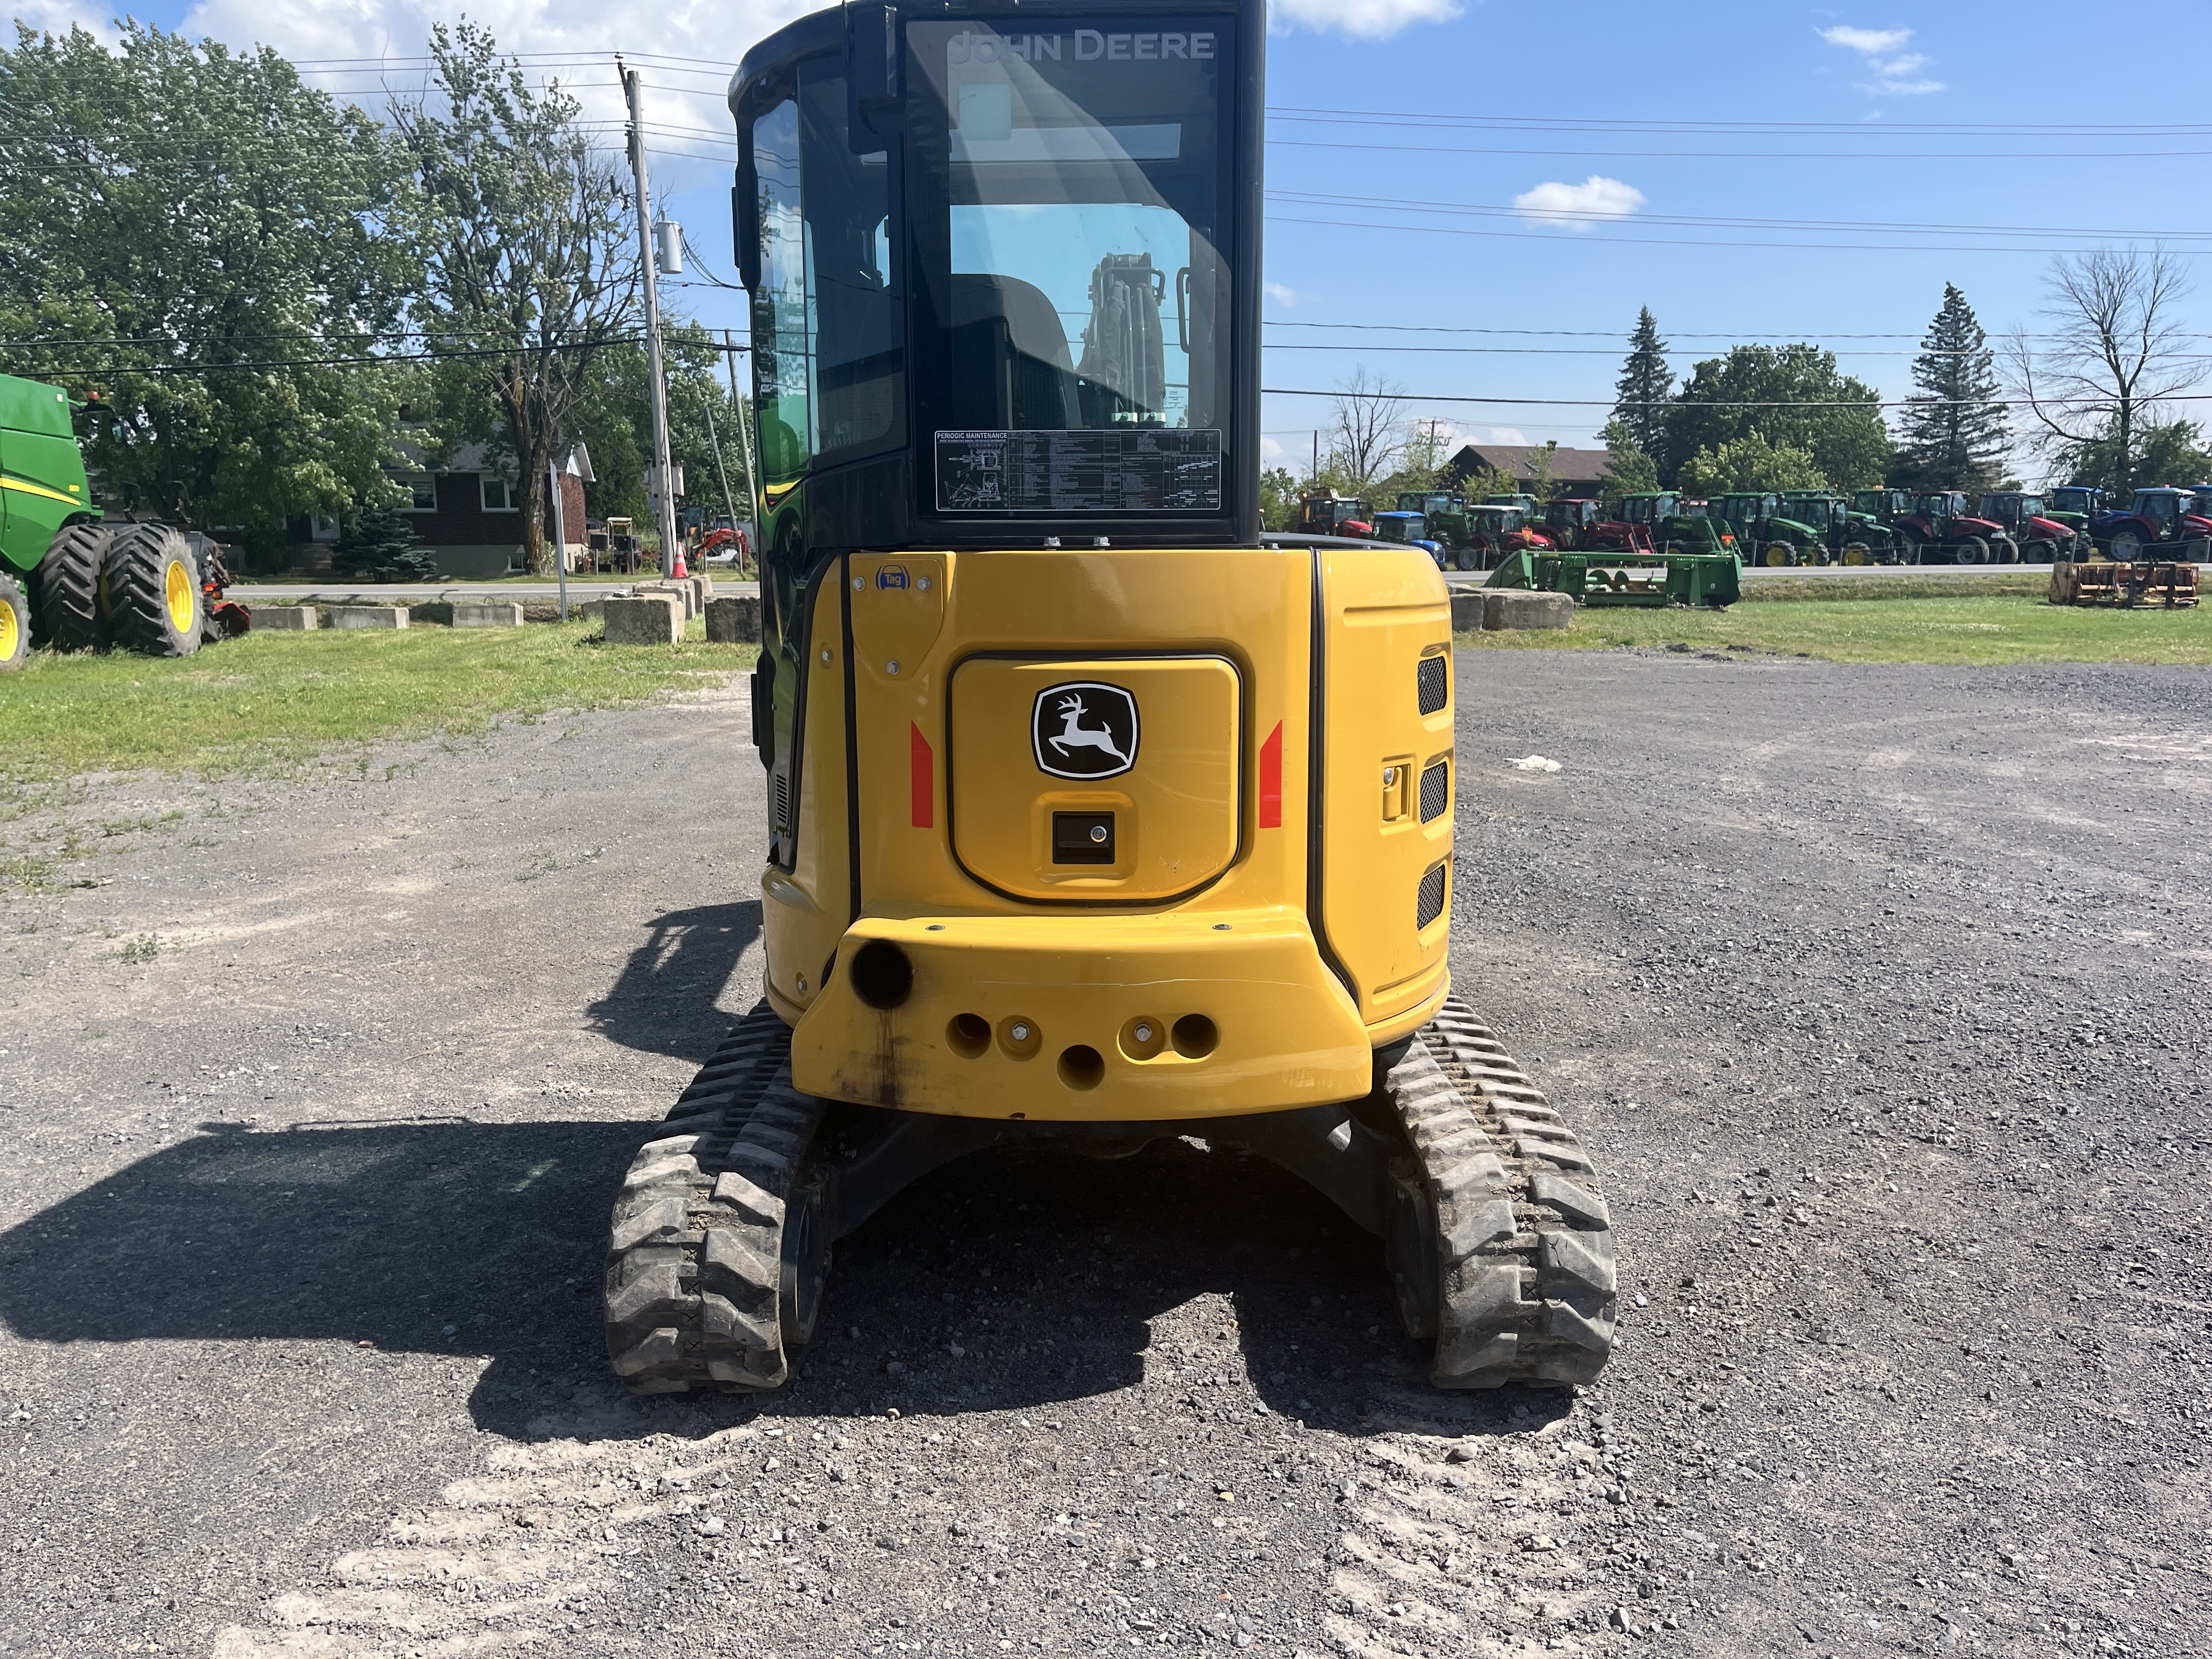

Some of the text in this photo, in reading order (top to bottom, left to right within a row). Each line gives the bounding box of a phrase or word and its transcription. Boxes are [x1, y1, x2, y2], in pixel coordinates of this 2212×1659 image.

[947, 29, 1215, 64] JOHN DEERE
[884, 574, 901, 586] Tag
